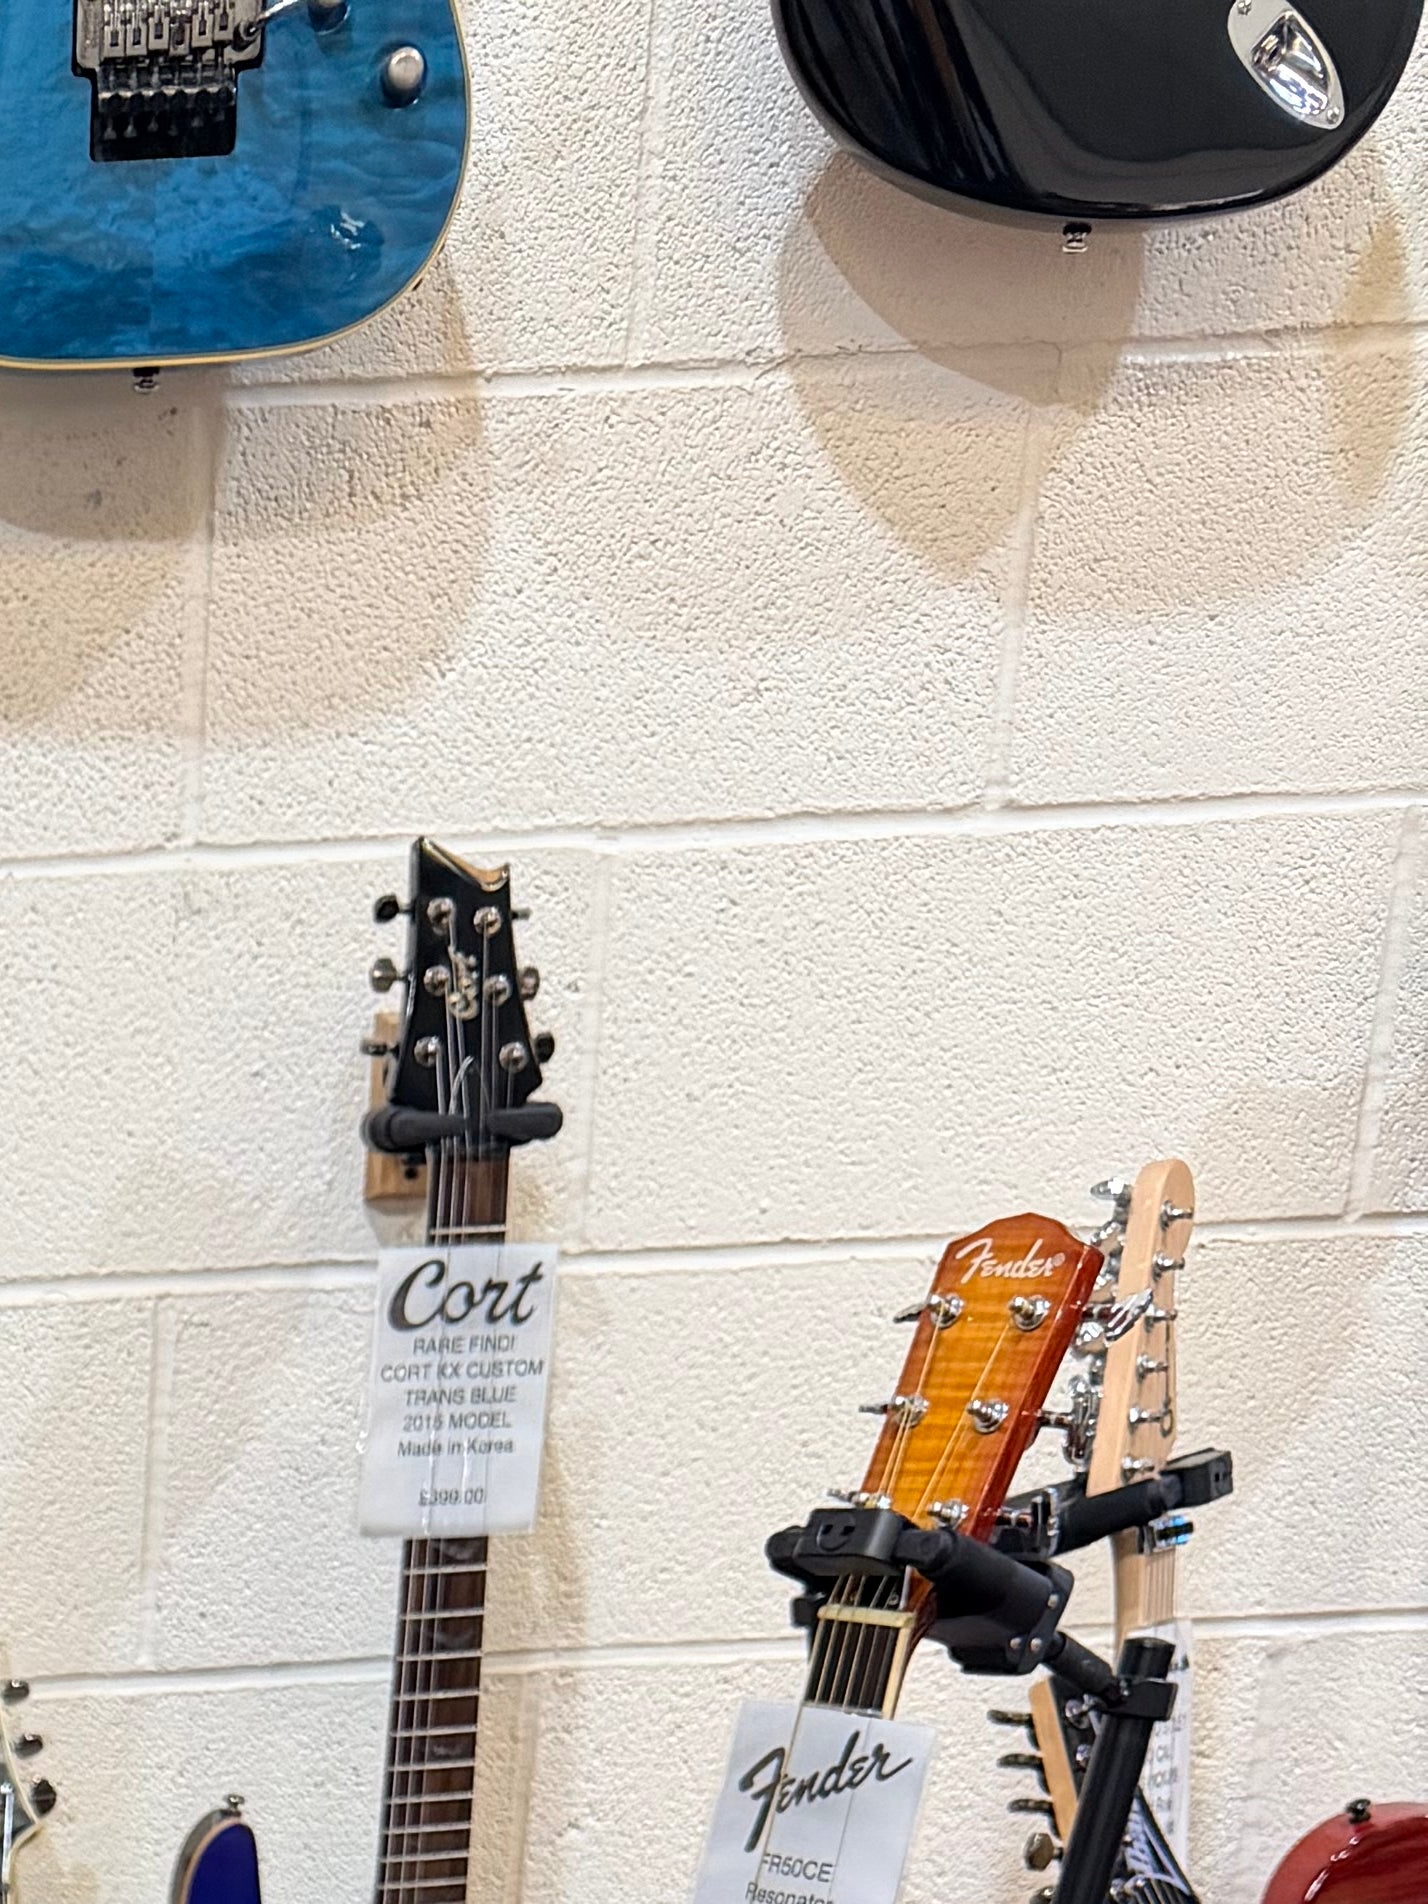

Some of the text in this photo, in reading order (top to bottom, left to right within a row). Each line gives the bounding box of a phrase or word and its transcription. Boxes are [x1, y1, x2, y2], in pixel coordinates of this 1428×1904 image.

[955, 1238, 1053, 1284] Fender
[388, 1260, 544, 1331] Cort
[413, 1337, 464, 1355] RARE
[381, 1364, 432, 1383] CORT
[467, 1360, 544, 1377] CUSTOM
[404, 1386, 516, 1406] TRANS BLUE
[448, 1411, 512, 1429] MODEL
[397, 1437, 513, 1457] Made in Korea
[738, 1730, 912, 1853] Fender
[761, 1852, 834, 1884] FR50CE
